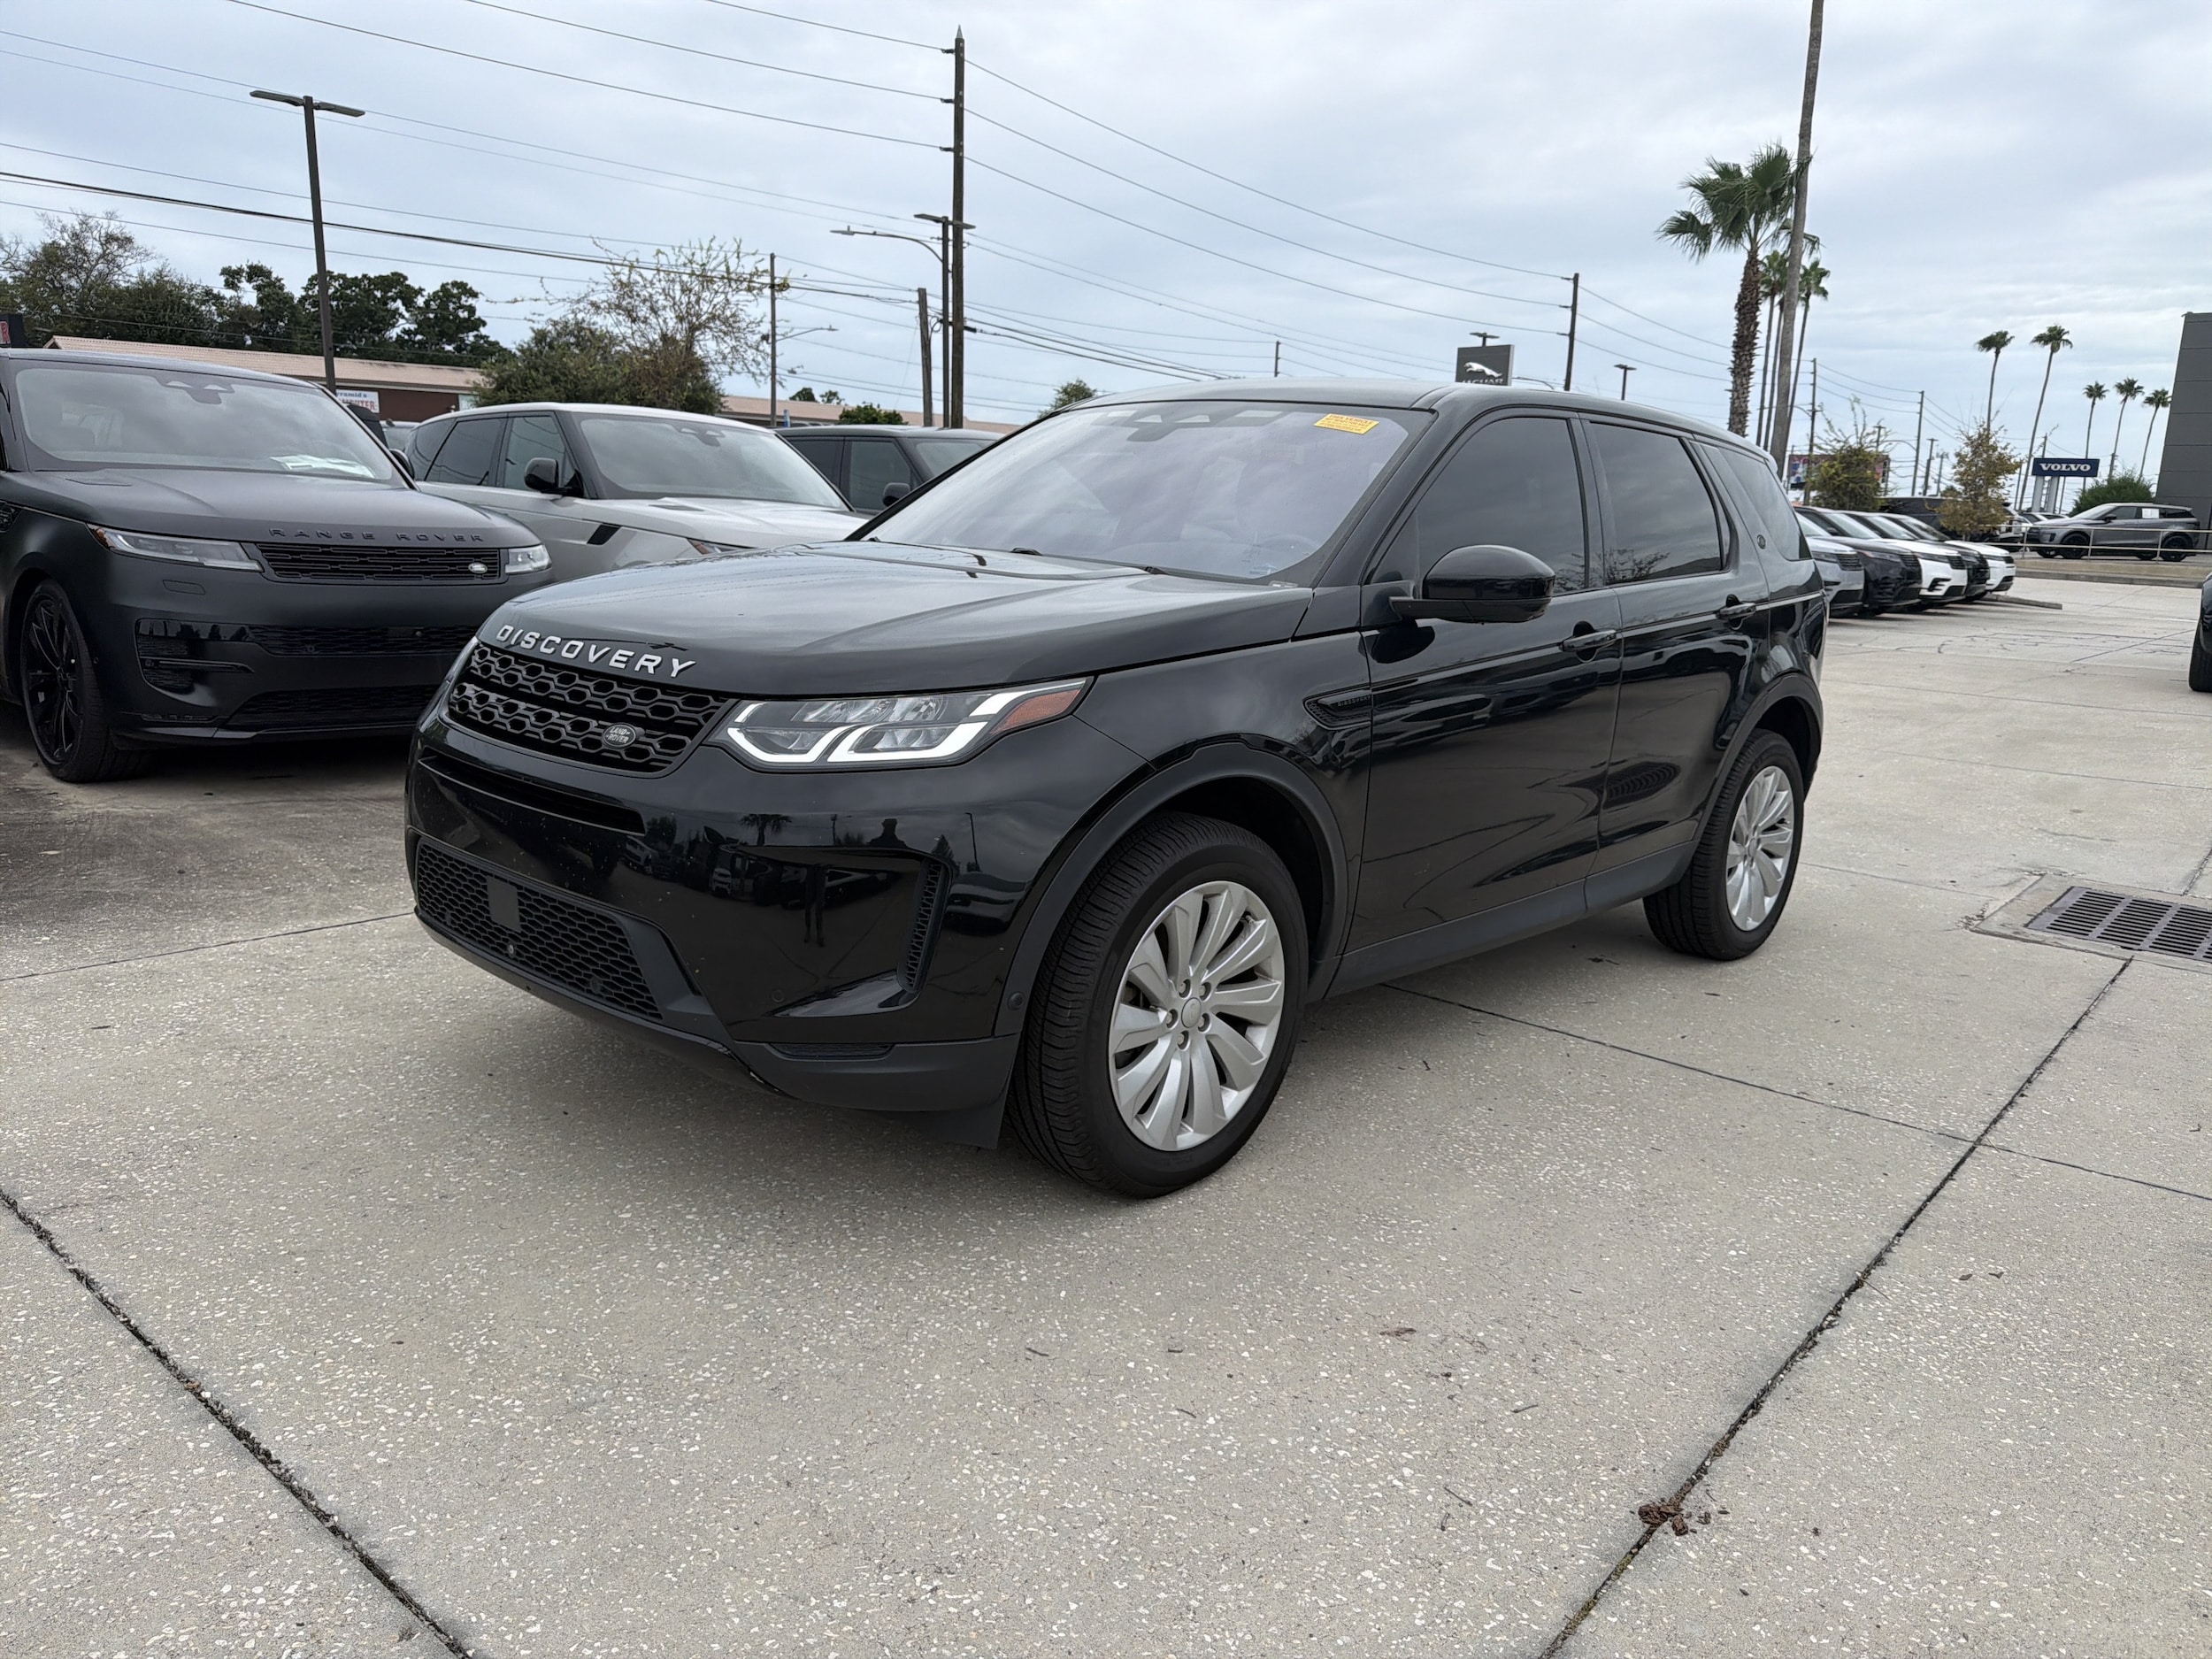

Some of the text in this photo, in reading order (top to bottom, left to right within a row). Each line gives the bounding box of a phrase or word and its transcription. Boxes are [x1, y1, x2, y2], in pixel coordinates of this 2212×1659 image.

[2039, 463, 2091, 472] VOLVO
[269, 528, 484, 542] RANGE ROVER
[495, 625, 696, 678] DISCOVERY
